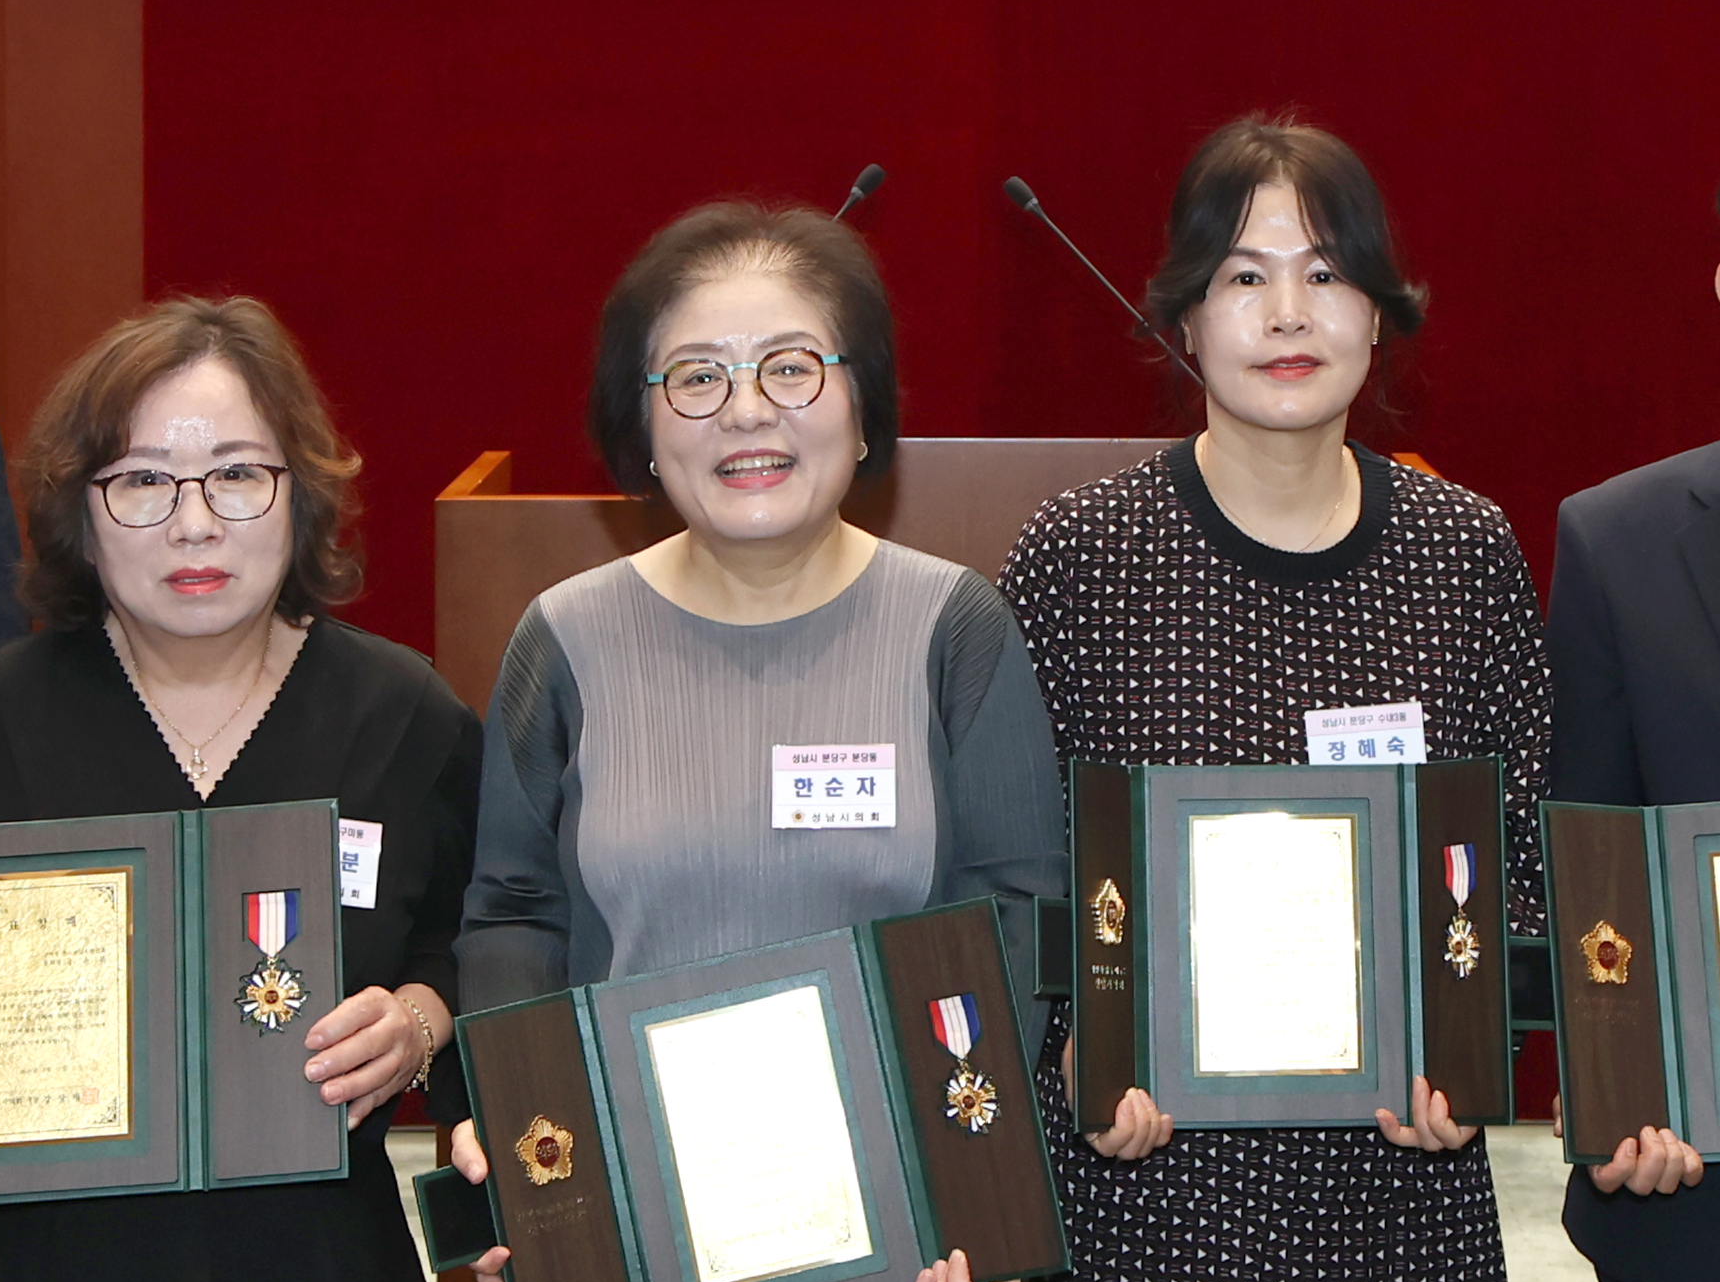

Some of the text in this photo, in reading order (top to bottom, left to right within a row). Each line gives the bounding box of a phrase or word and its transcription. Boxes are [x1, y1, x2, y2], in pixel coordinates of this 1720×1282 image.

[792, 752, 877, 764] 성남시 분당구 분당동
